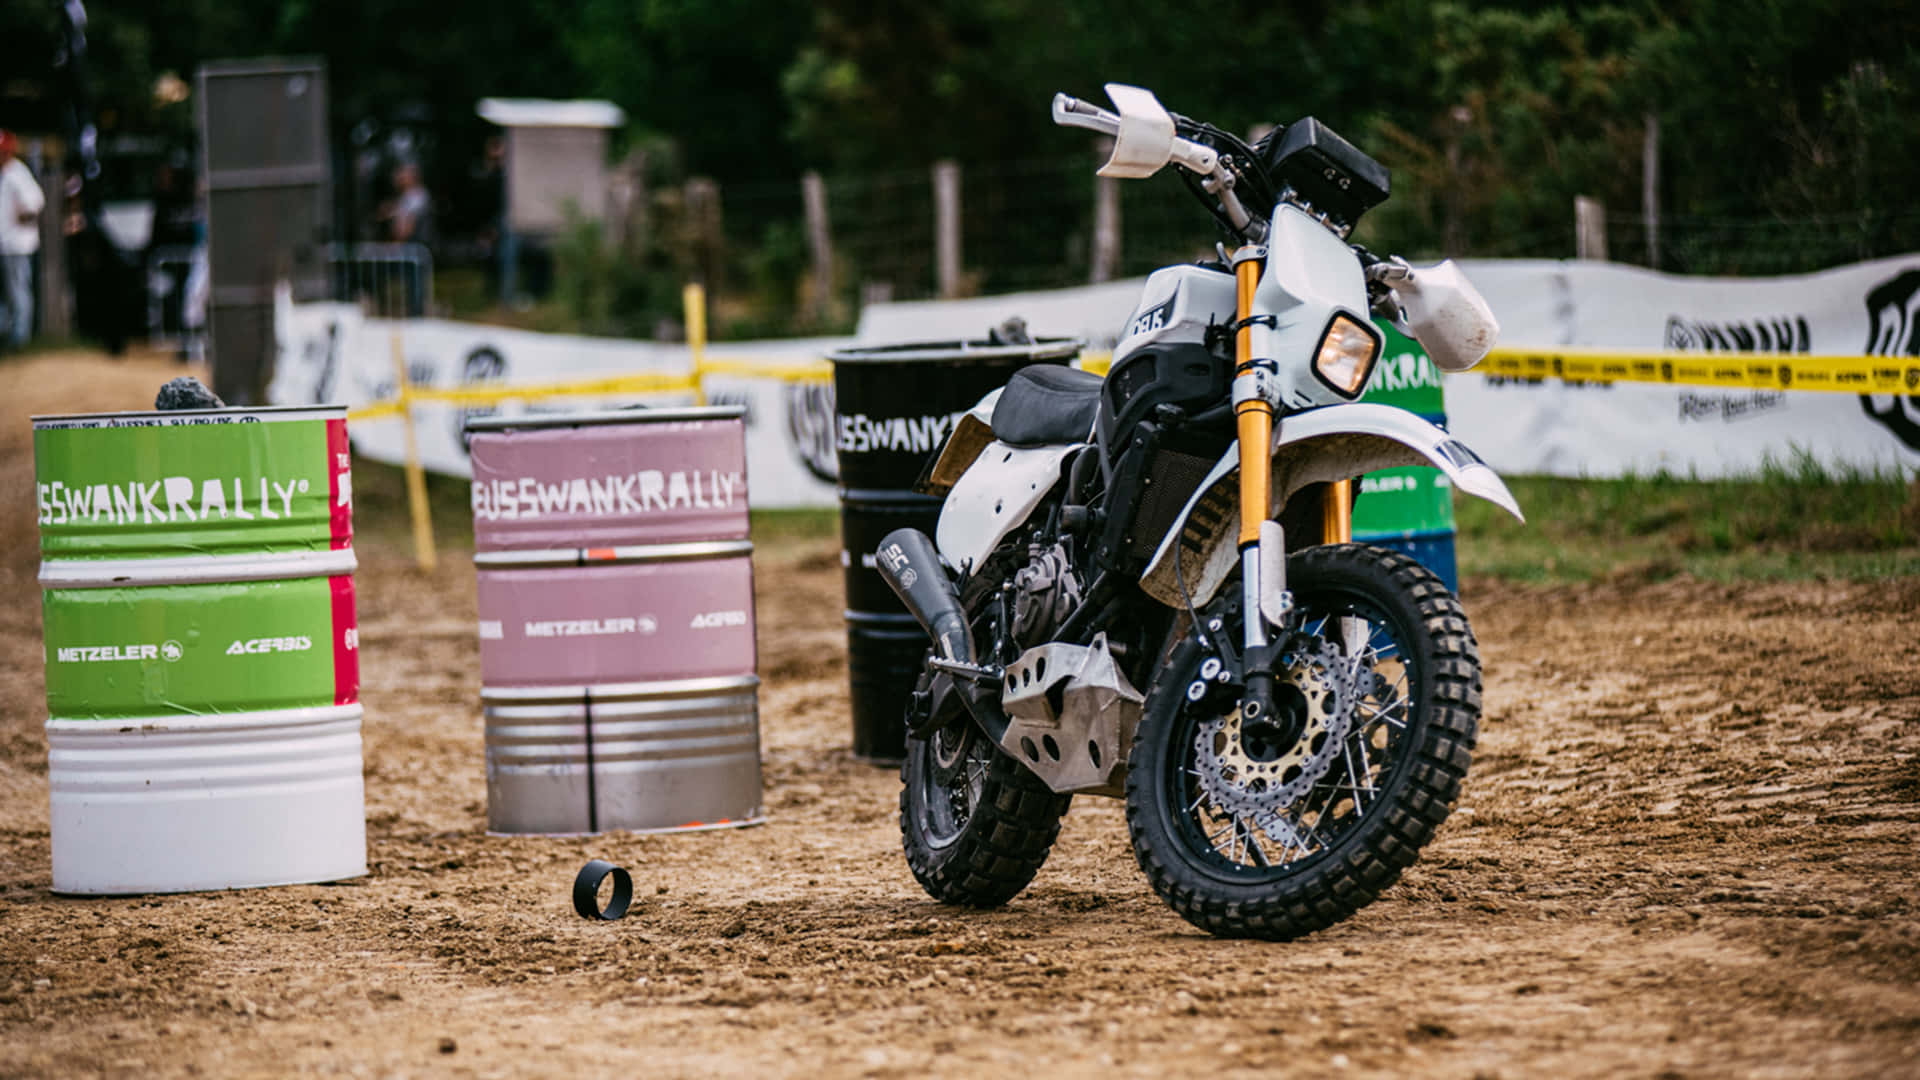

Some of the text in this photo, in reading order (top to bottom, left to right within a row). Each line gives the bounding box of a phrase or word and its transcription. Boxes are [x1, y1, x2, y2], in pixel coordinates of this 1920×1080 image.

[525, 618, 635, 637] METZELER
[57, 636, 312, 663] METZELER ACERBIS
